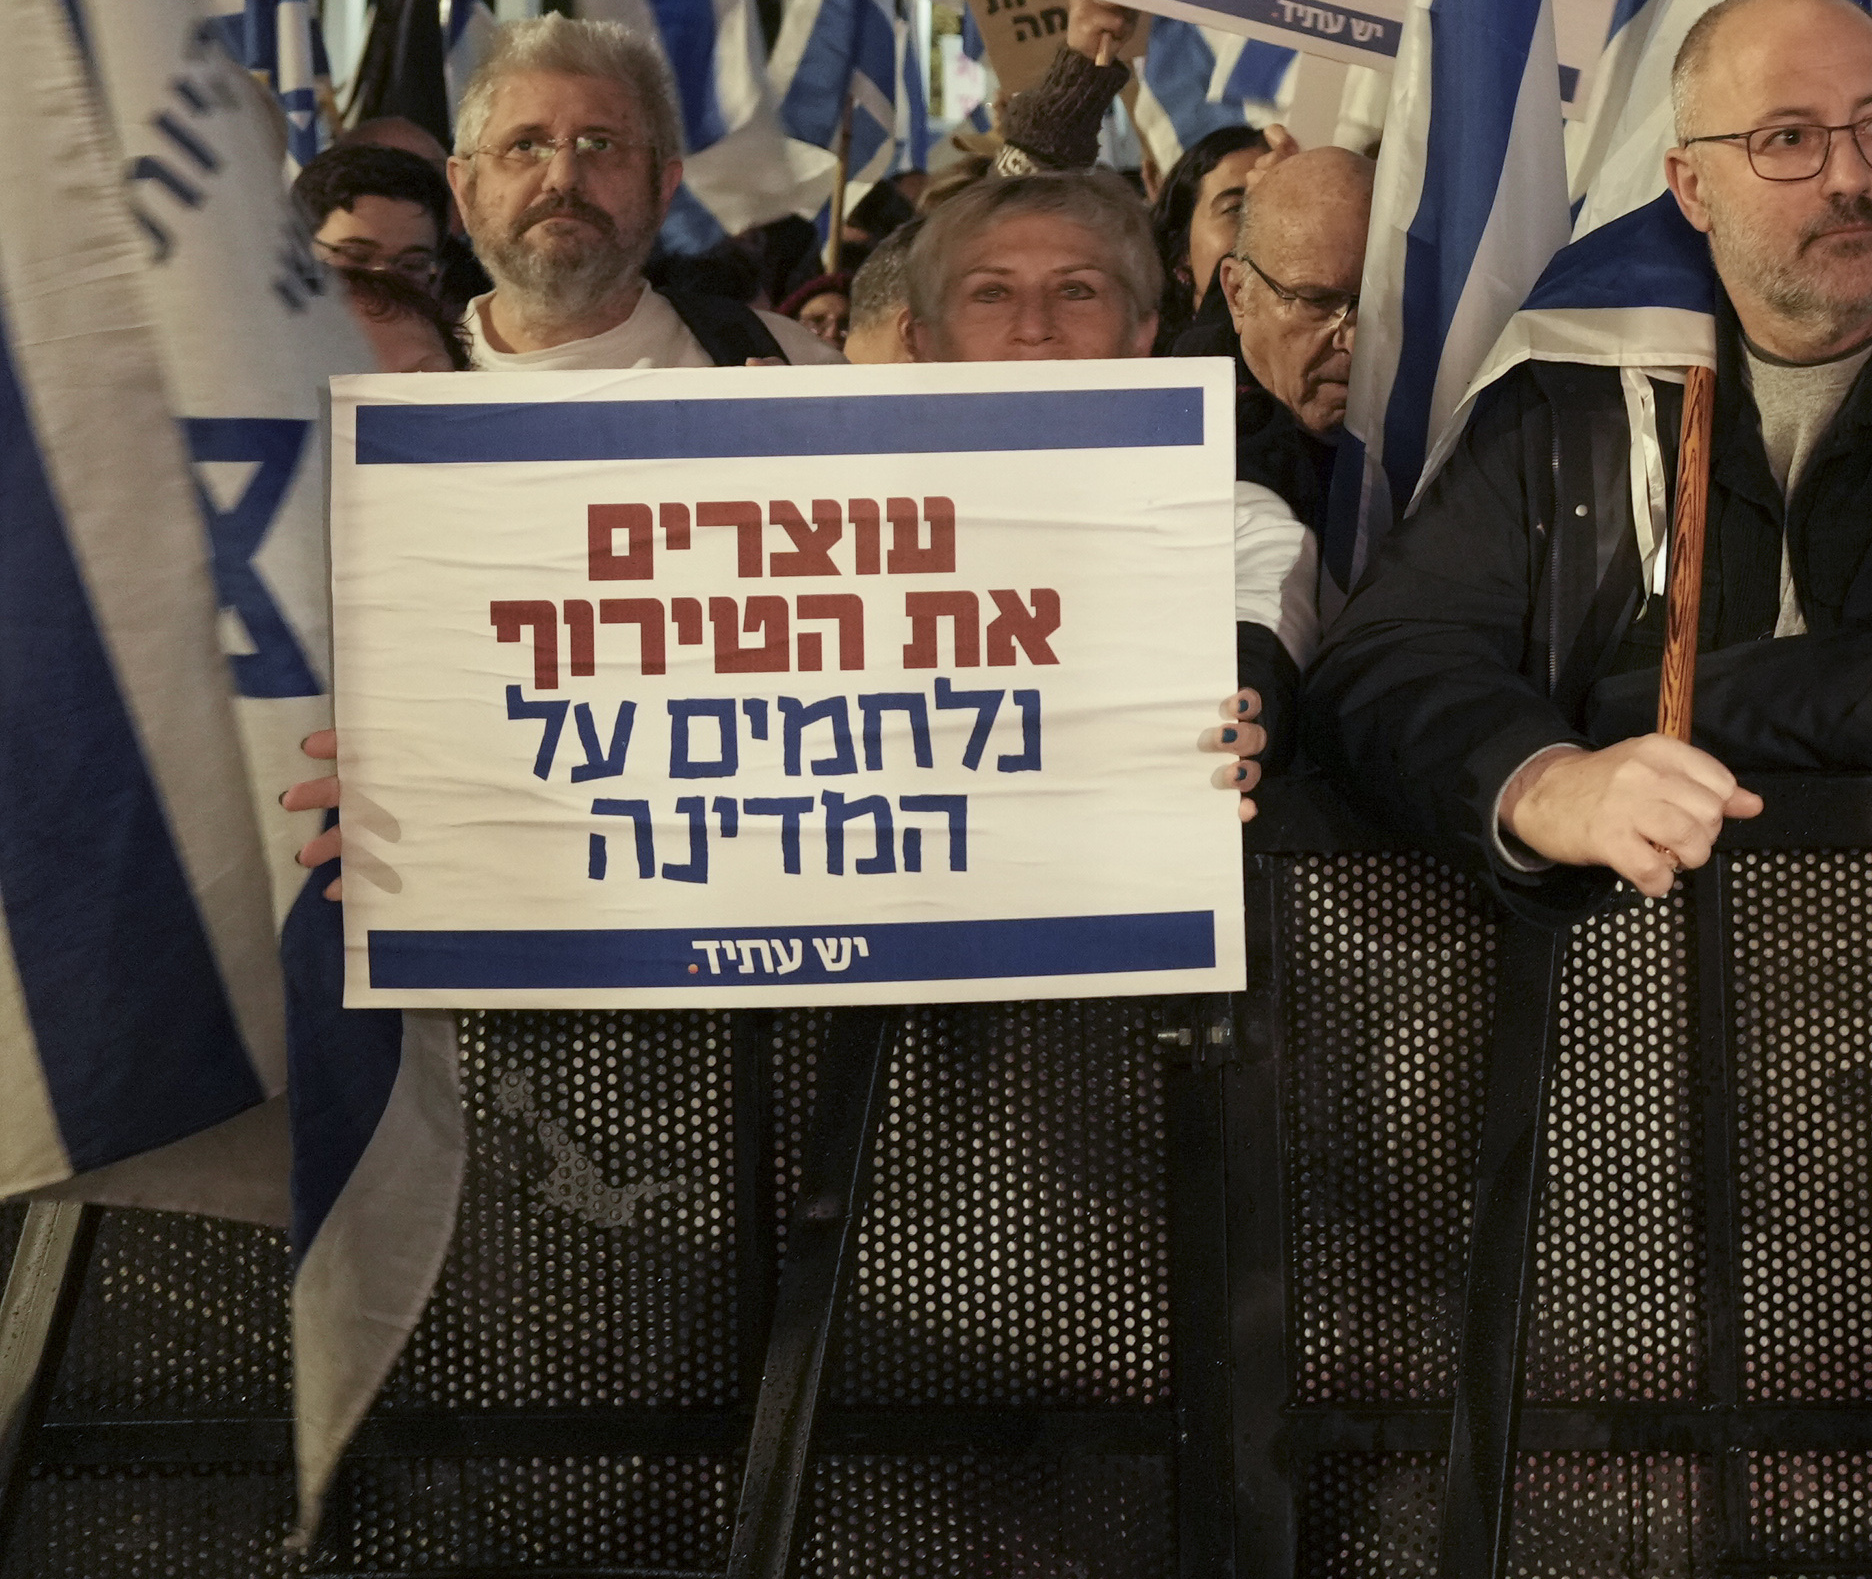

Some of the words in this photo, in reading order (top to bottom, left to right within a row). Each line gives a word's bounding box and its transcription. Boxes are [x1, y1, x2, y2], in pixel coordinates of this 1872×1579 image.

[1350, 17, 1385, 43] יש
[587, 496, 956, 582] עוצרים
[490, 592, 865, 690] הטירוף
[903, 587, 1061, 671] את
[506, 684, 638, 783] על
[668, 678, 1041, 780] נלחמים
[588, 789, 968, 884] המדינה
[813, 936, 869, 972] יש
